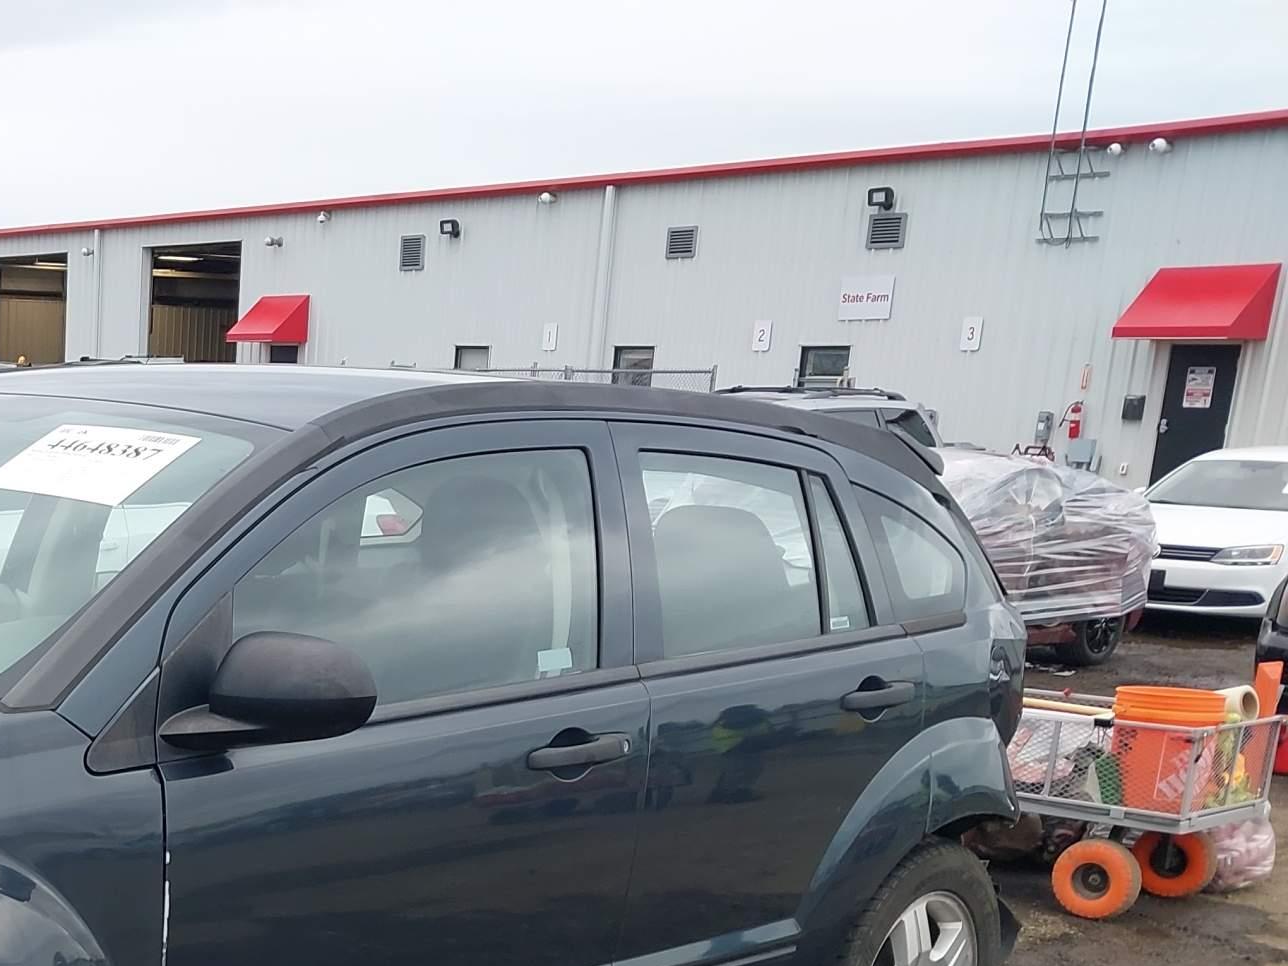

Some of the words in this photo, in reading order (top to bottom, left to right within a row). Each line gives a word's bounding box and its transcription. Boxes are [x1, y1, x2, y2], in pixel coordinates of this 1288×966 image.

[841, 292, 864, 304] State
[865, 292, 889, 303] Farm
[758, 328, 766, 342] 2
[967, 326, 975, 341] 3
[47, 438, 164, 461] 44648387
